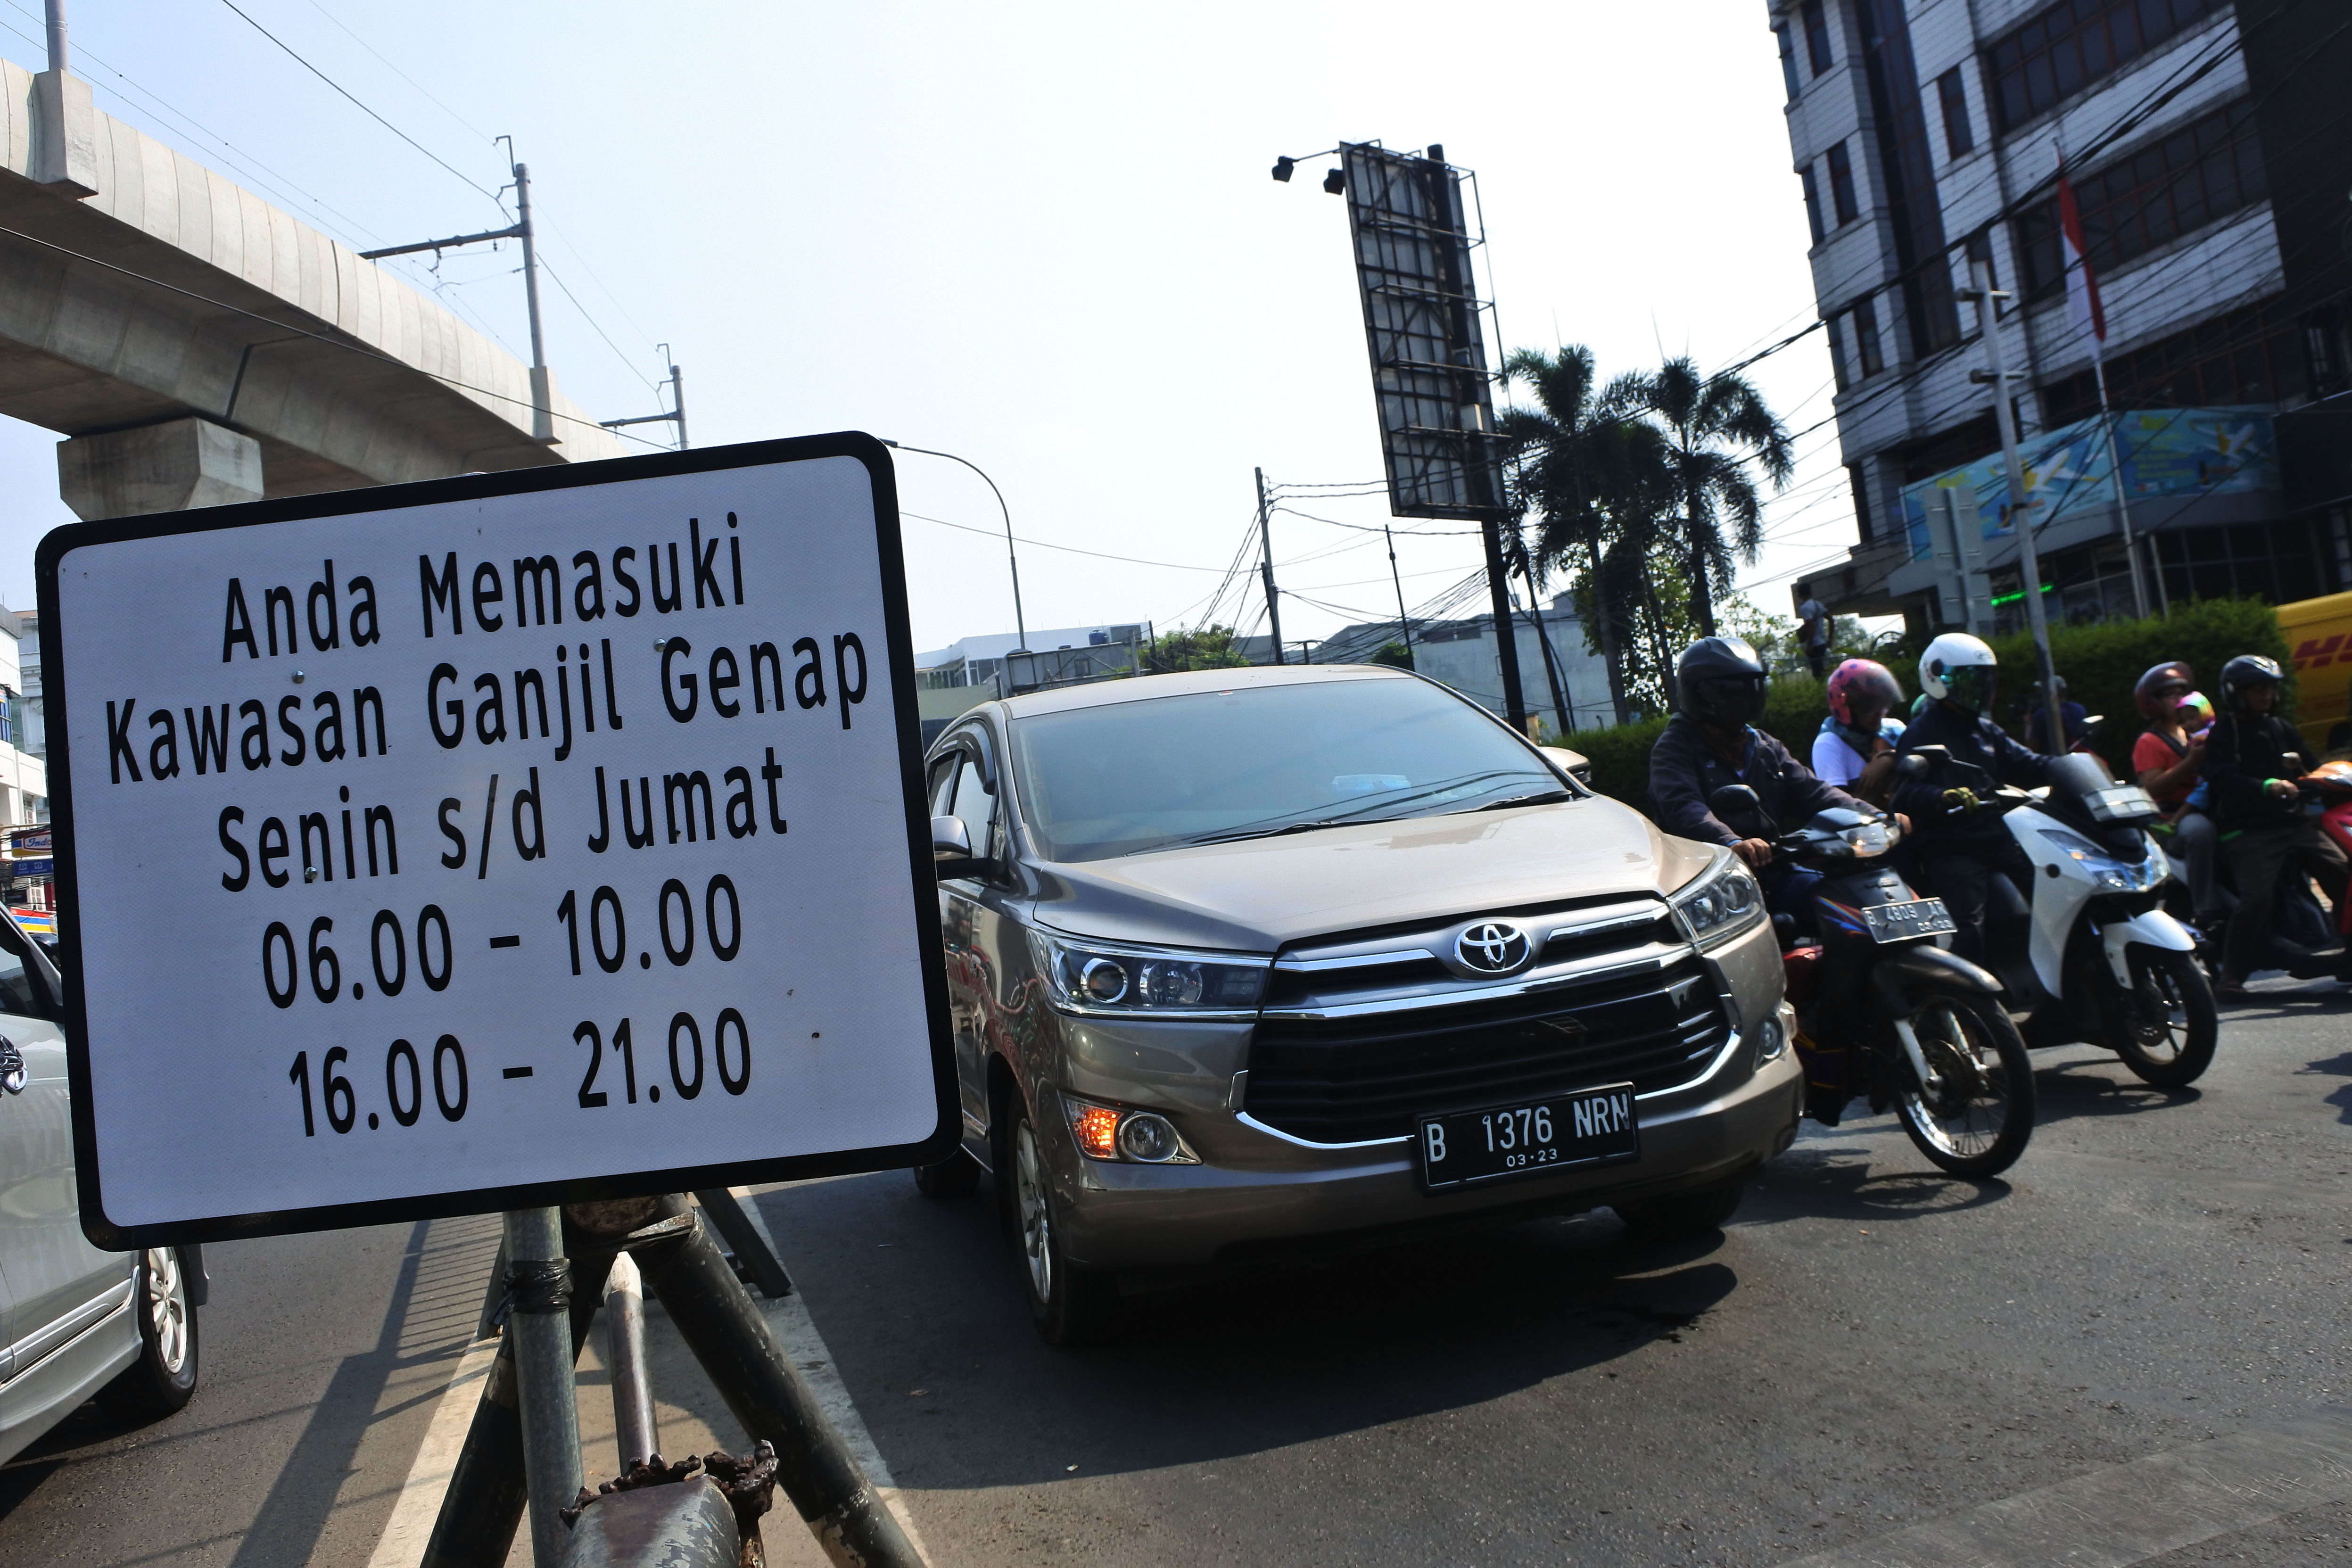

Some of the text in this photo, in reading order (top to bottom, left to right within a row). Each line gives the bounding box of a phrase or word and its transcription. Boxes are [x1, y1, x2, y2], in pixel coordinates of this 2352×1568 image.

[222, 511, 744, 664] Anda Memasuki
[106, 631, 868, 785] Kawasan Ganjil Genap
[218, 746, 788, 893] Senin s/d Jumat
[262, 873, 742, 1010] 06.00 - 10.00
[1864, 910, 1877, 925] B
[289, 1007, 751, 1138] 16.00 - 21.00
[1426, 1093, 1630, 1163] B 1376 NRN
